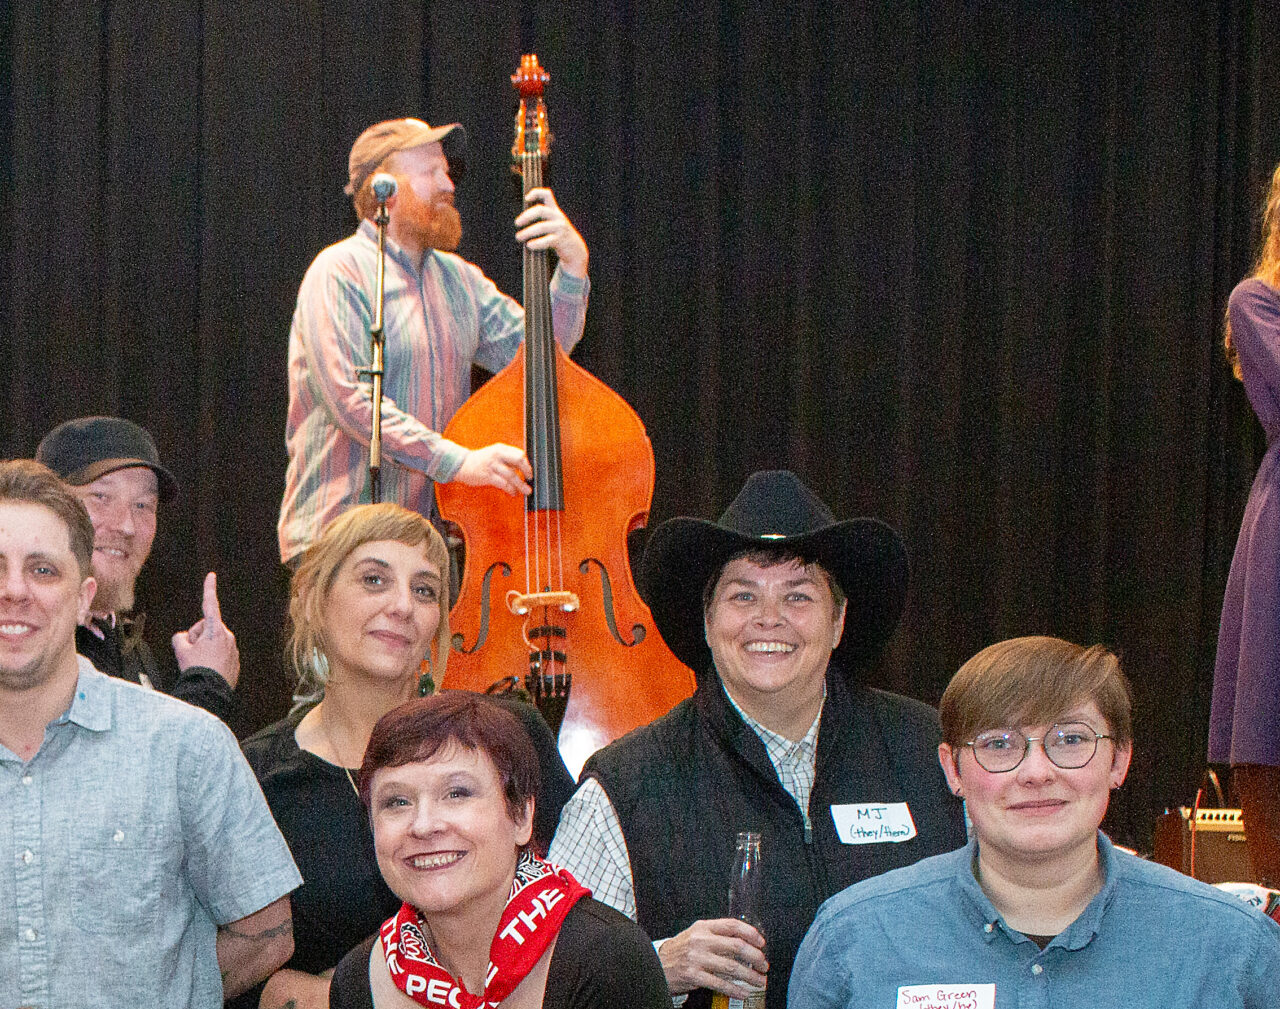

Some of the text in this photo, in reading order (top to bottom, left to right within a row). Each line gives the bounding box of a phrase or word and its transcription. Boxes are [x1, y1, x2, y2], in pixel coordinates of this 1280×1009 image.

[856, 808, 888, 820] MJ
[498, 887, 565, 946] THE
[901, 989, 977, 1005] Sam Green
